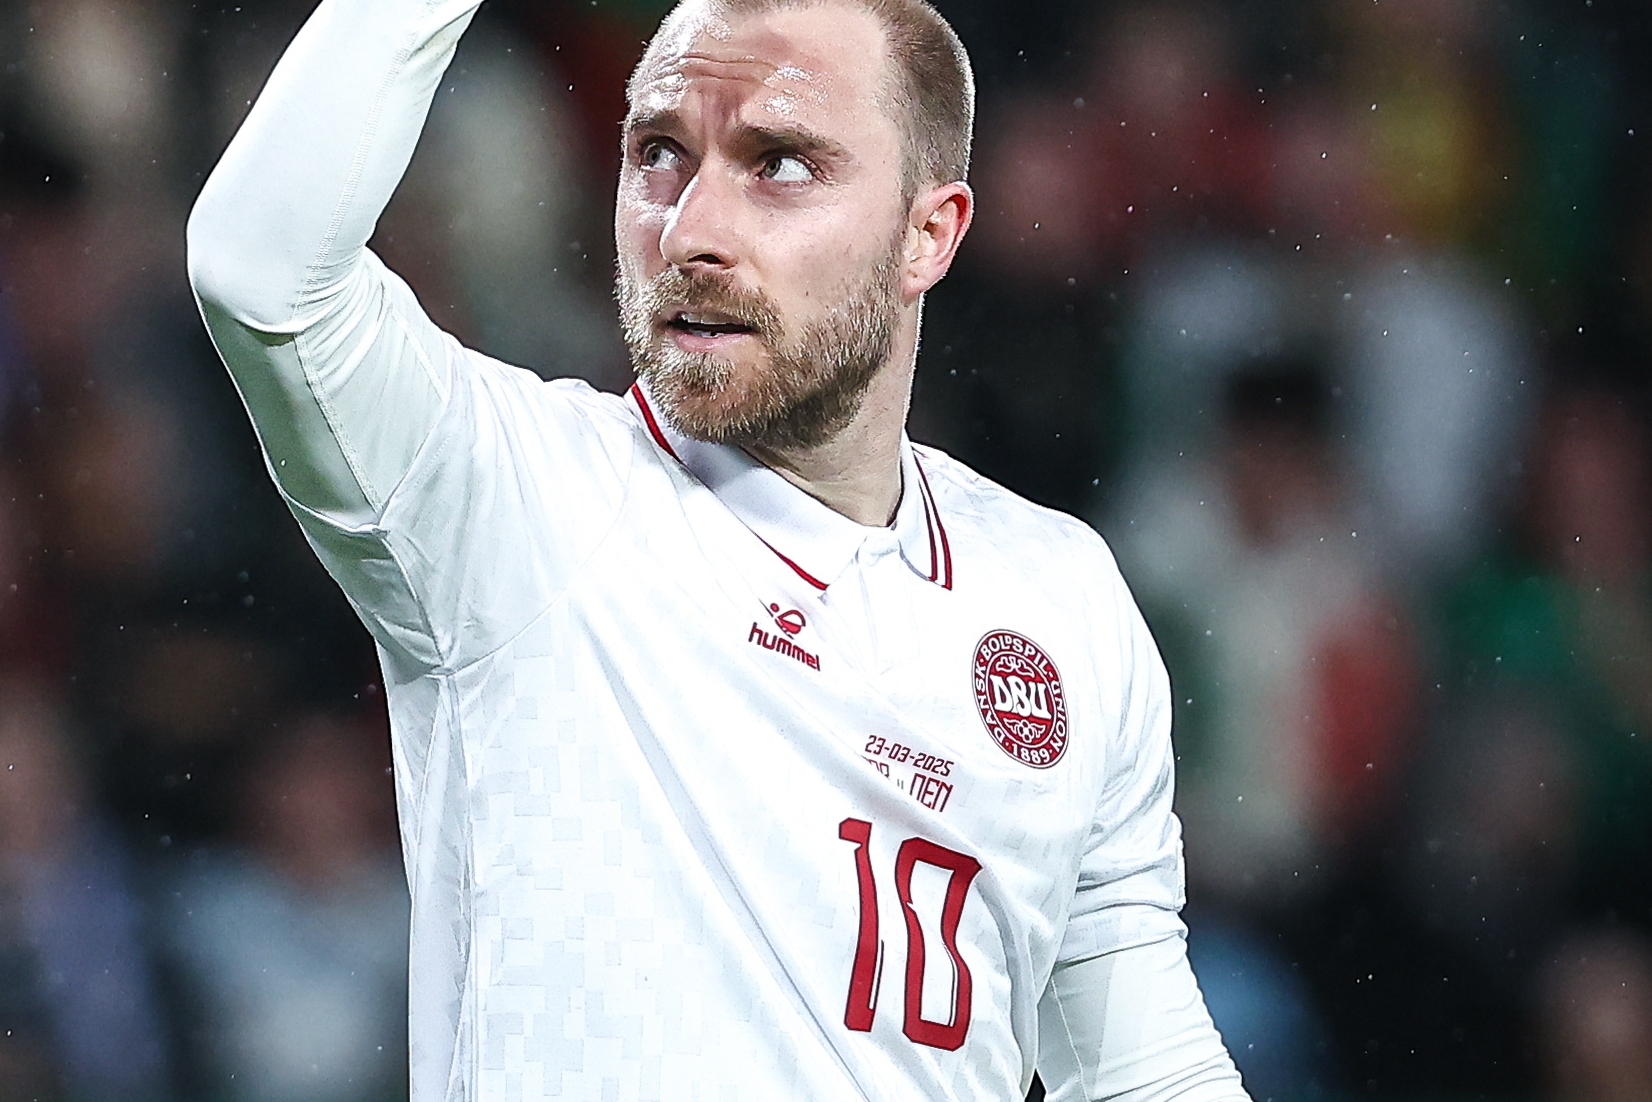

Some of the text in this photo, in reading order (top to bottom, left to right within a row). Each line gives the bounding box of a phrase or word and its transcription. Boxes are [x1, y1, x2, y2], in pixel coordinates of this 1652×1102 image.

[748, 621, 821, 672] hummel
[975, 660, 1006, 744] DANSK
[1049, 679, 1067, 753] UNION
[989, 674, 1053, 720] DBU
[864, 734, 955, 777] 23-03-2025
[1011, 743, 1051, 765] 1889
[838, 817, 983, 1052] 10
